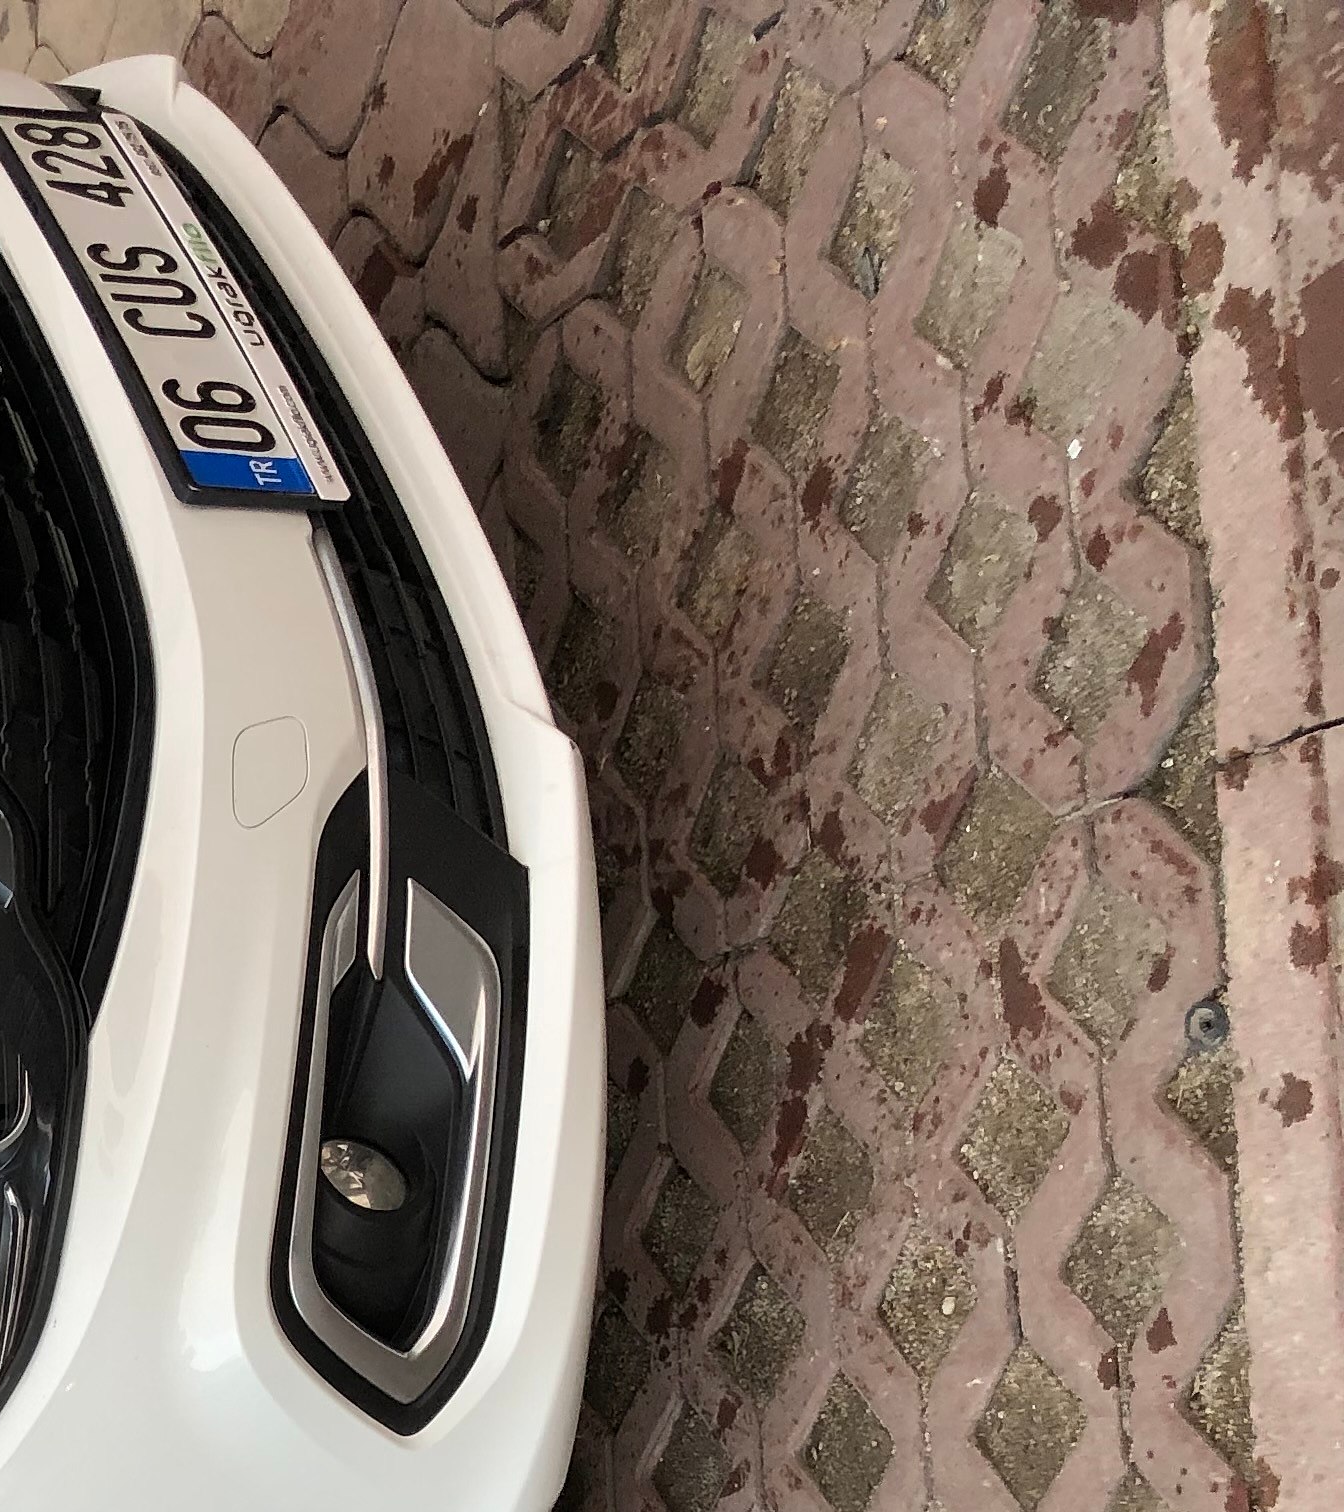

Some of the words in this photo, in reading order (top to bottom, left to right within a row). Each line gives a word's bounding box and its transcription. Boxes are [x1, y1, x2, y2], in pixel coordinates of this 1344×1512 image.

[14, 122, 134, 208] 428
[86, 243, 217, 340] CUS
[161, 378, 277, 453] 06
[248, 460, 282, 486] TR
